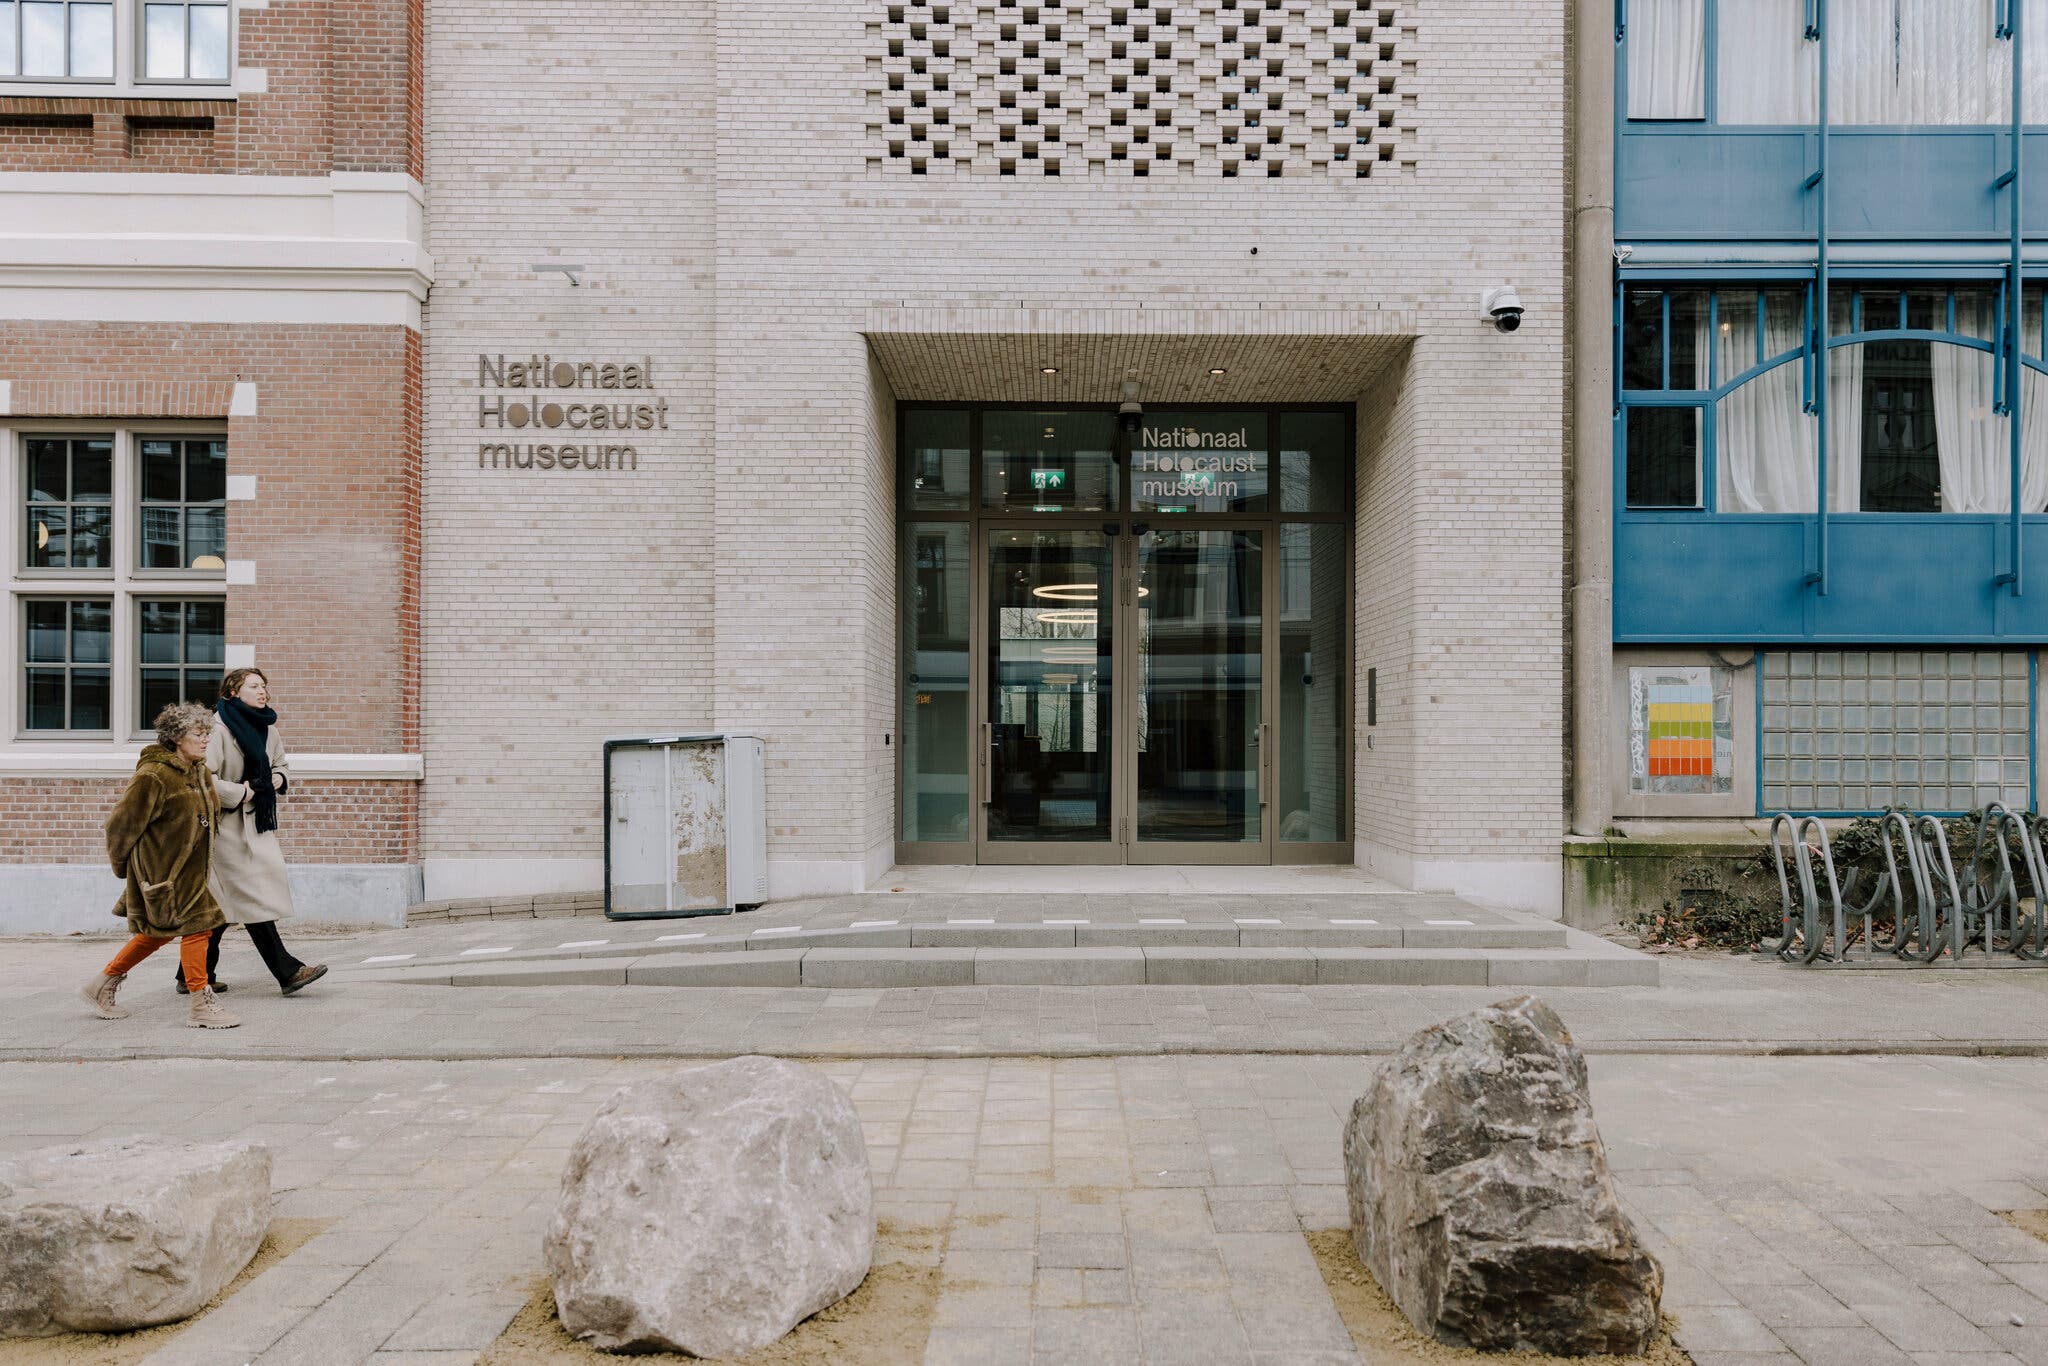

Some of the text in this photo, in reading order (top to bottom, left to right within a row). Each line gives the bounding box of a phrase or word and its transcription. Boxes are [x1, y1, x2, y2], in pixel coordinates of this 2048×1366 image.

[479, 354, 653, 388] Nationaal
[479, 395, 669, 429] Holocaust
[1142, 427, 1247, 448] Nationaal
[479, 443, 637, 469] museum
[1142, 452, 1256, 473] Holocaust
[1142, 479, 1238, 497] museum
